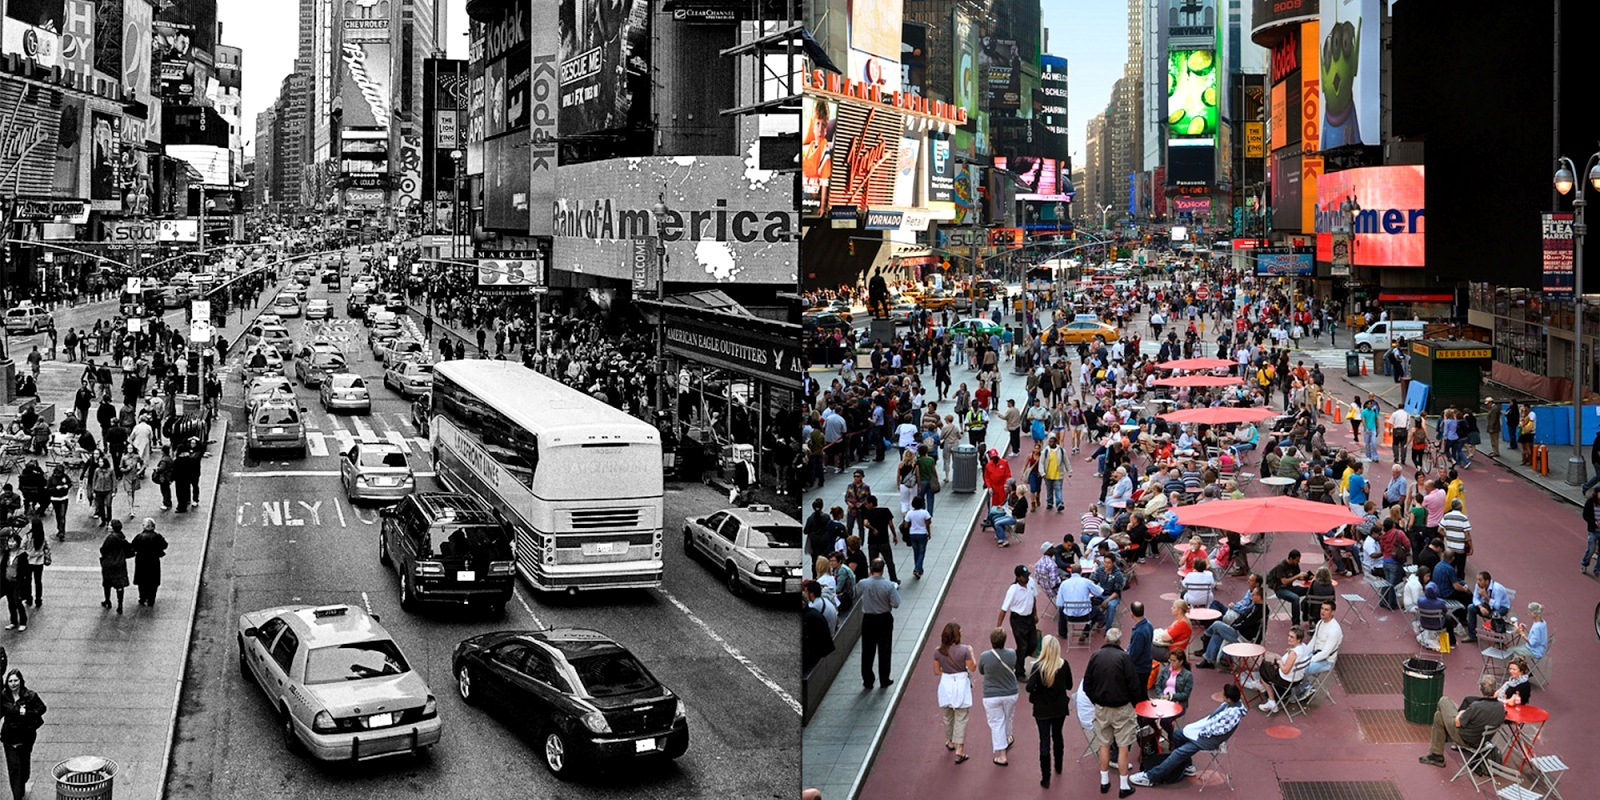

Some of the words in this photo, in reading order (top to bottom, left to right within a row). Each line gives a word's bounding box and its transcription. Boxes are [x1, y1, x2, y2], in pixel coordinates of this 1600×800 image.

[344, 20, 388, 29] CHEVROLET
[486, 1, 525, 61] Kodak
[1169, 27, 1214, 36] CHEVROLET
[1271, 32, 1297, 82] Kodak
[561, 55, 588, 82] RESCUE
[588, 50, 600, 73] ME
[892, 89, 968, 123] BUILDING
[533, 54, 556, 172] Kodak
[439, 124, 454, 134] LION
[1302, 79, 1322, 180] Kodak
[439, 134, 454, 143] KING
[1247, 135, 1262, 144] LION
[1247, 144, 1262, 153] KING
[348, 191, 384, 201] YAHOO!
[1174, 199, 1211, 209] YAHOO!
[867, 214, 902, 226] VORNADO
[904, 215, 926, 227] Retail
[1542, 224, 1573, 234] FLEA
[634, 238, 646, 290] WELCOME
[666, 327, 698, 346] AMERICAN
[698, 334, 720, 352] EAGLE
[720, 339, 768, 365] OUTFITTERS
[1437, 350, 1492, 359] NEWSSTAND
[483, 456, 500, 488] LINES
